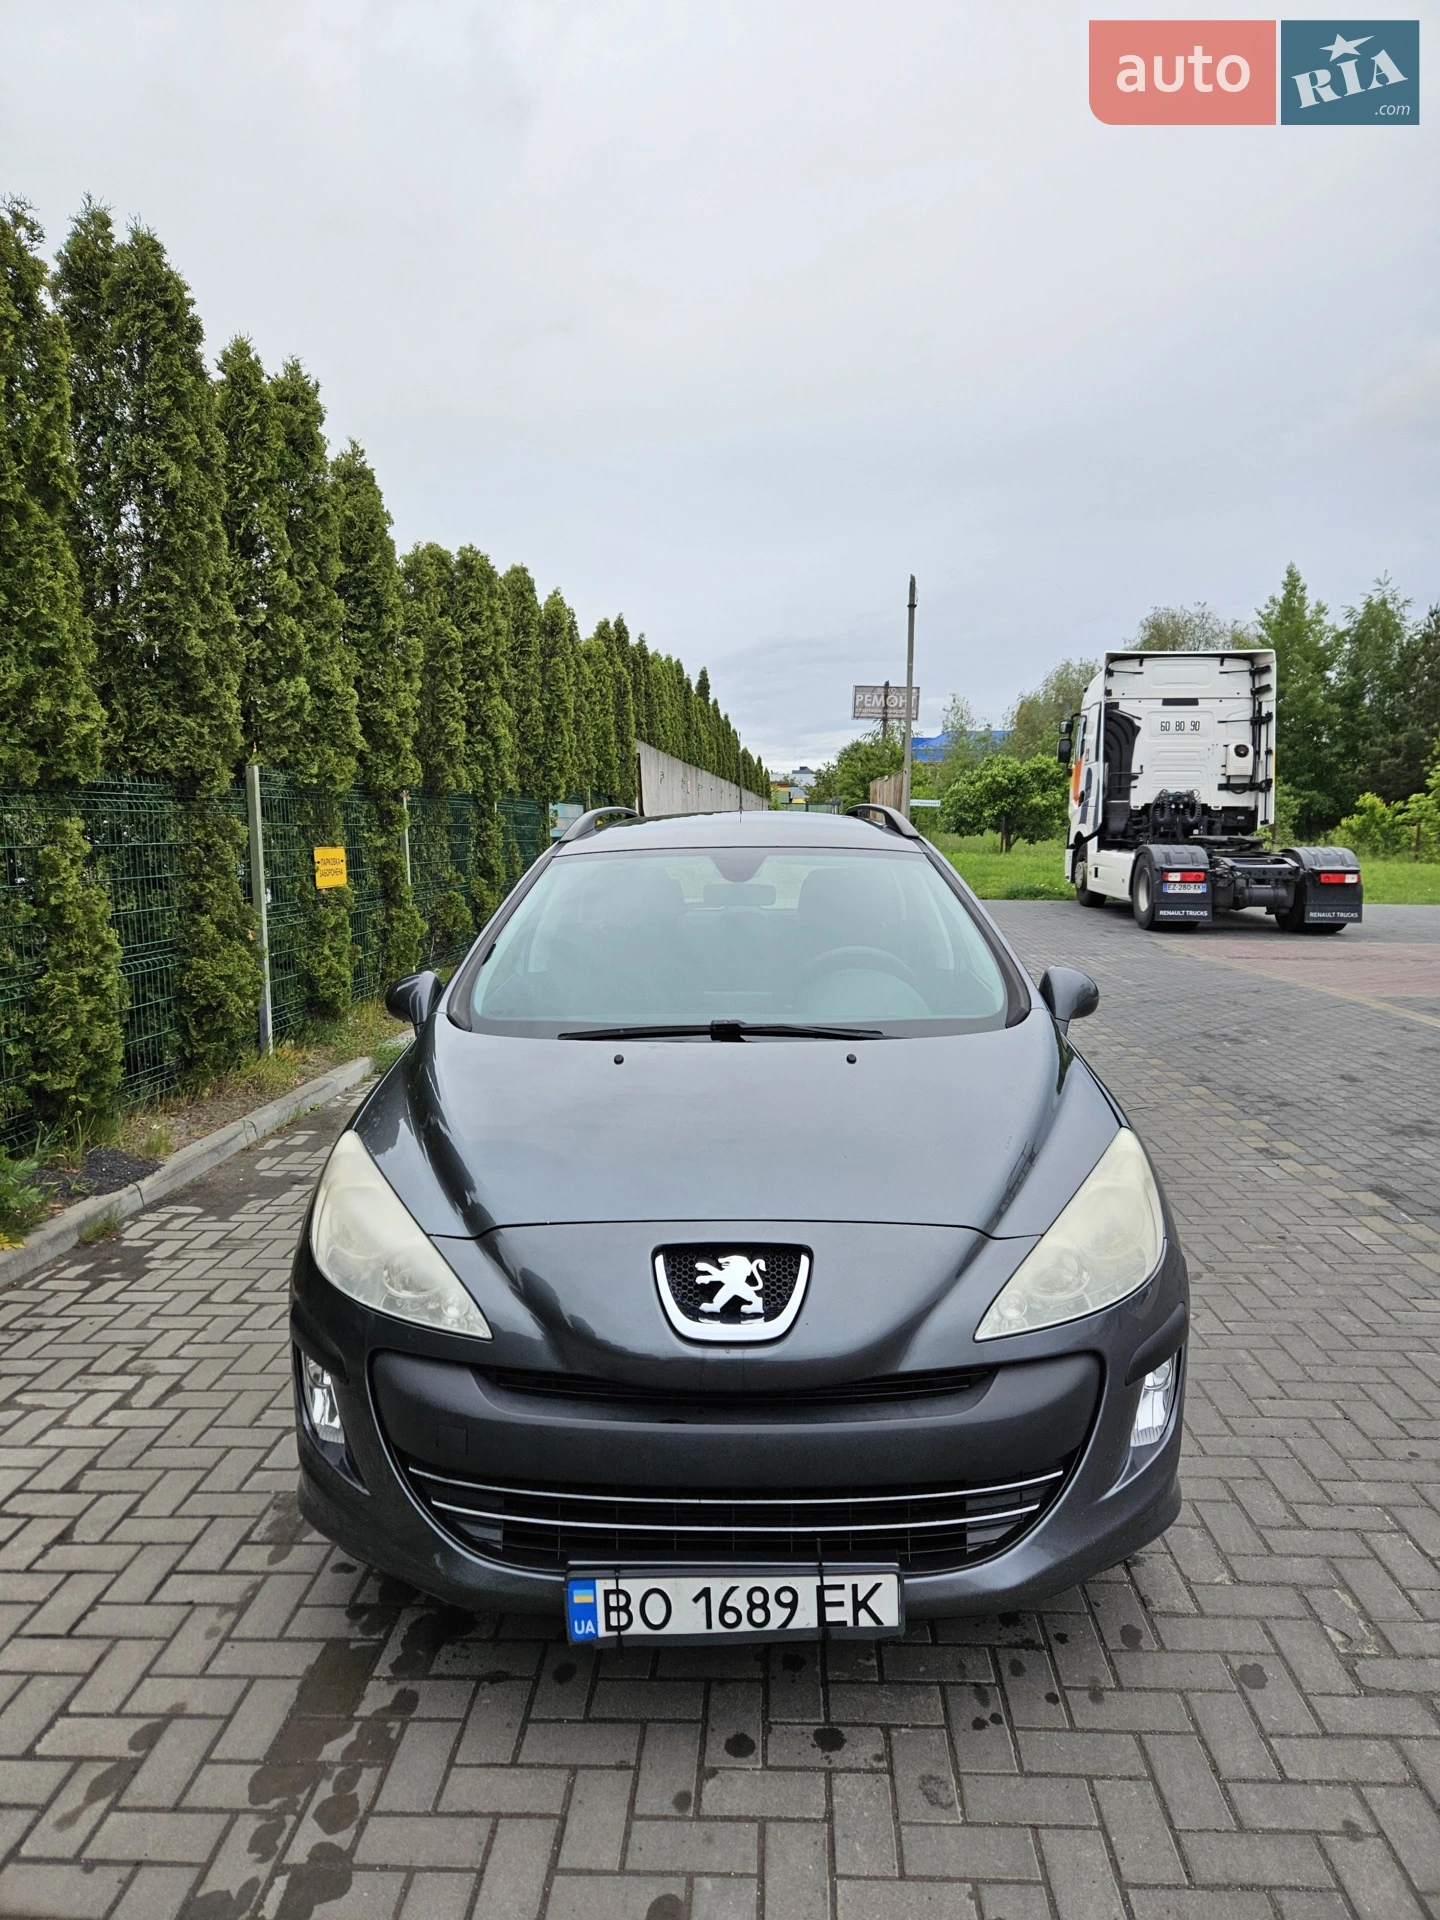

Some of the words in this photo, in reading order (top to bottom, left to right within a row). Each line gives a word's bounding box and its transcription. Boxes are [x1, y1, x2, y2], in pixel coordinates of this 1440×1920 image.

[1160, 720, 1171, 731] 60
[1175, 720, 1185, 731] 80
[1190, 720, 1200, 731] 90
[320, 857, 341, 866] ПАРКОВКА
[319, 868, 343, 877] ЗАБОРОНЕНА
[603, 1588, 672, 1632] BO
[691, 1585, 799, 1630] 1689
[816, 1582, 885, 1627] EK
[574, 1621, 596, 1635] UA
